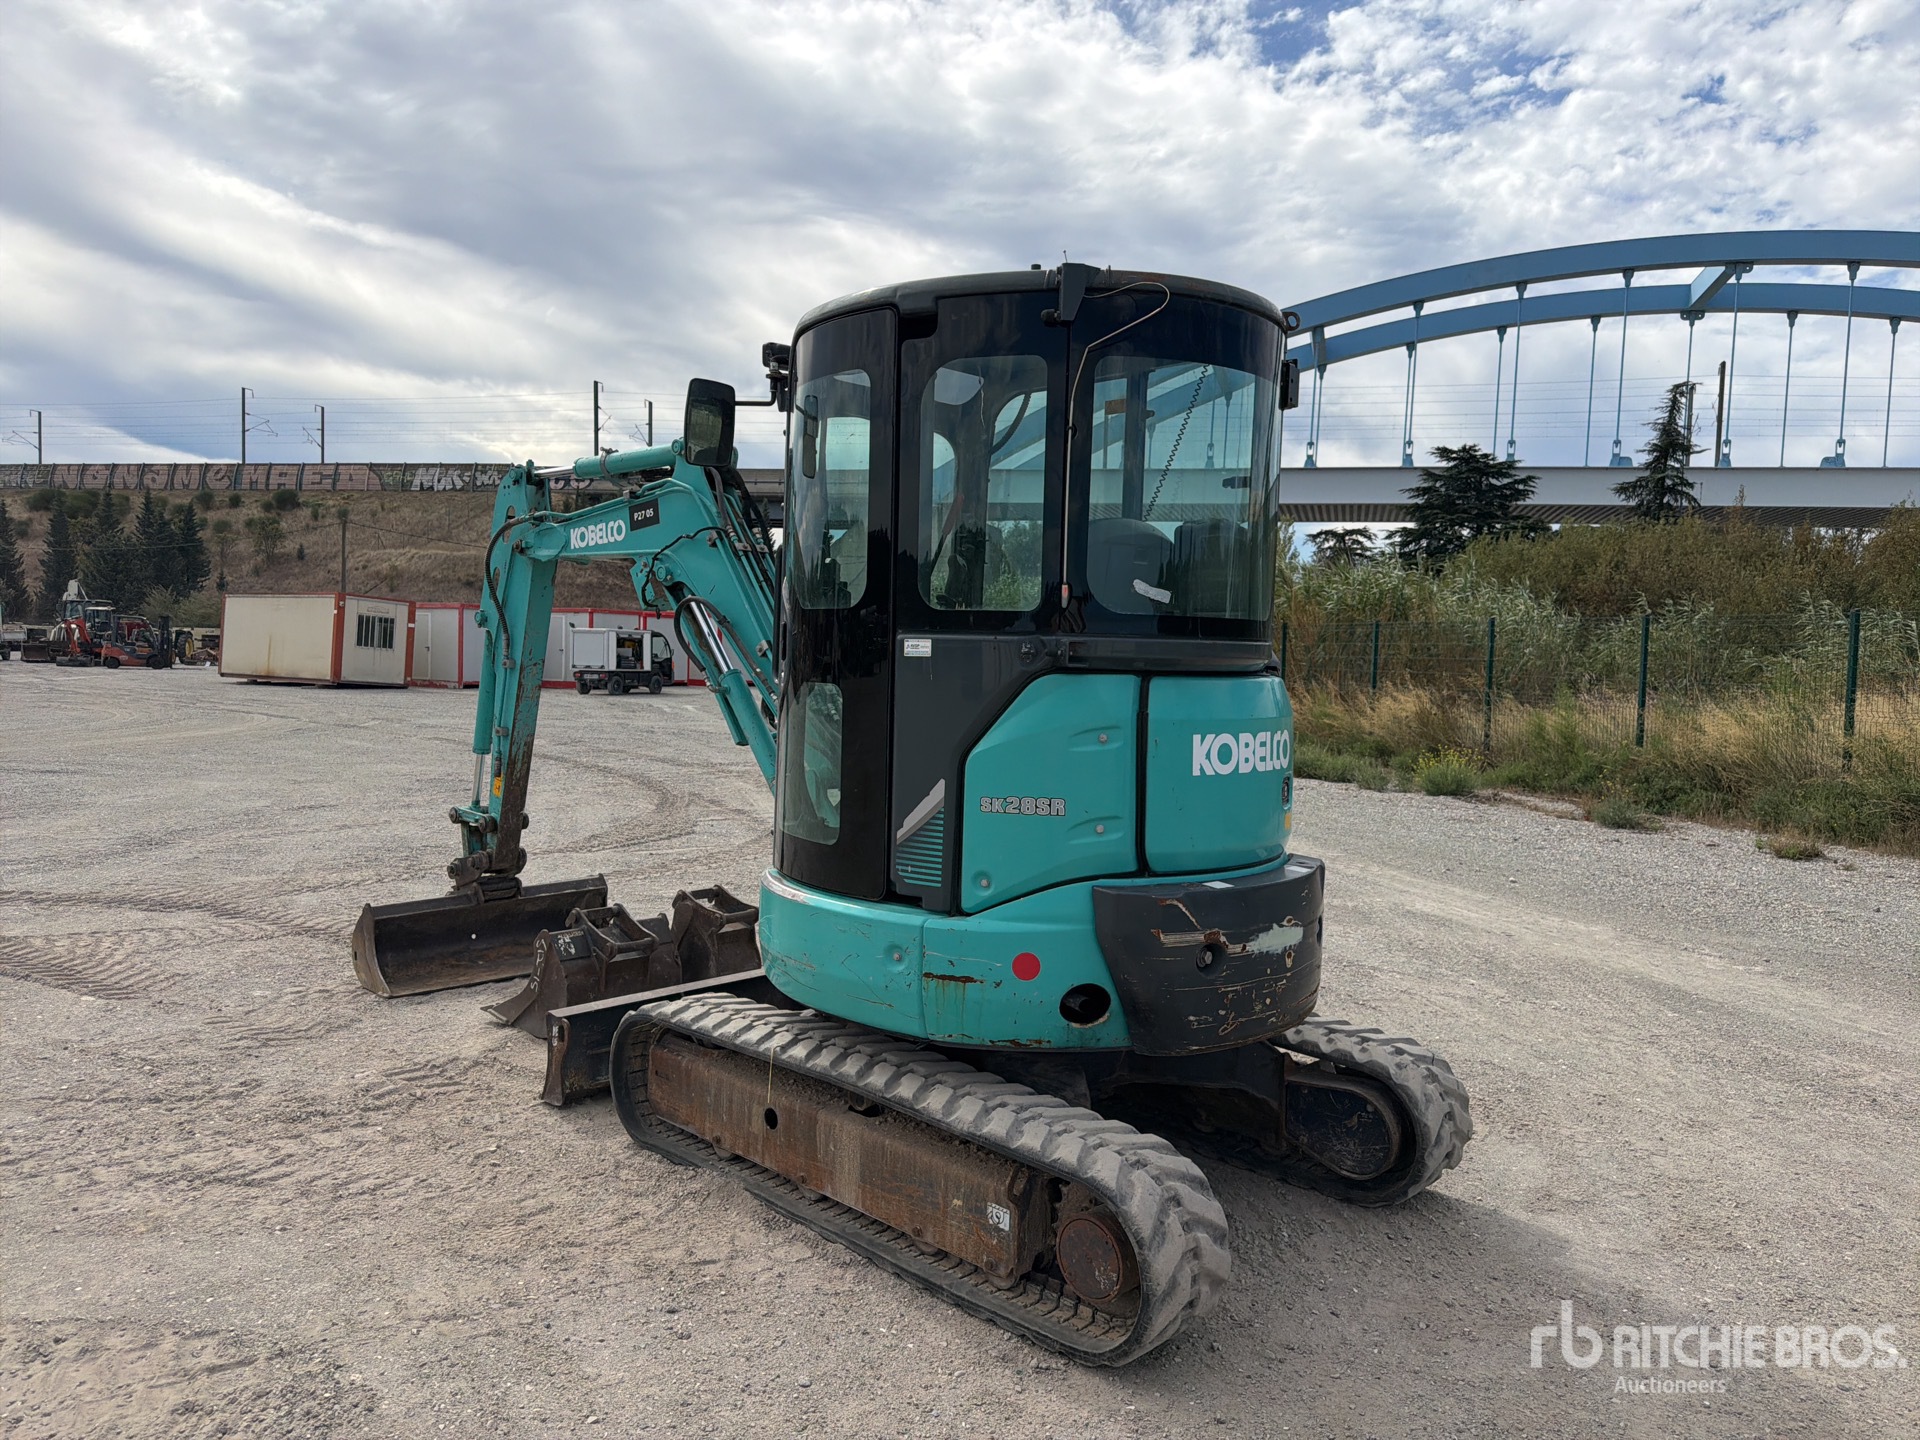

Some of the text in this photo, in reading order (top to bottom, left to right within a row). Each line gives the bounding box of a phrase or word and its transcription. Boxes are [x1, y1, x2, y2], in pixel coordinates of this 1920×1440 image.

[570, 519, 626, 549] KOBELCO
[1192, 730, 1290, 776] KOBELCO
[980, 796, 1066, 816] SK28SR
